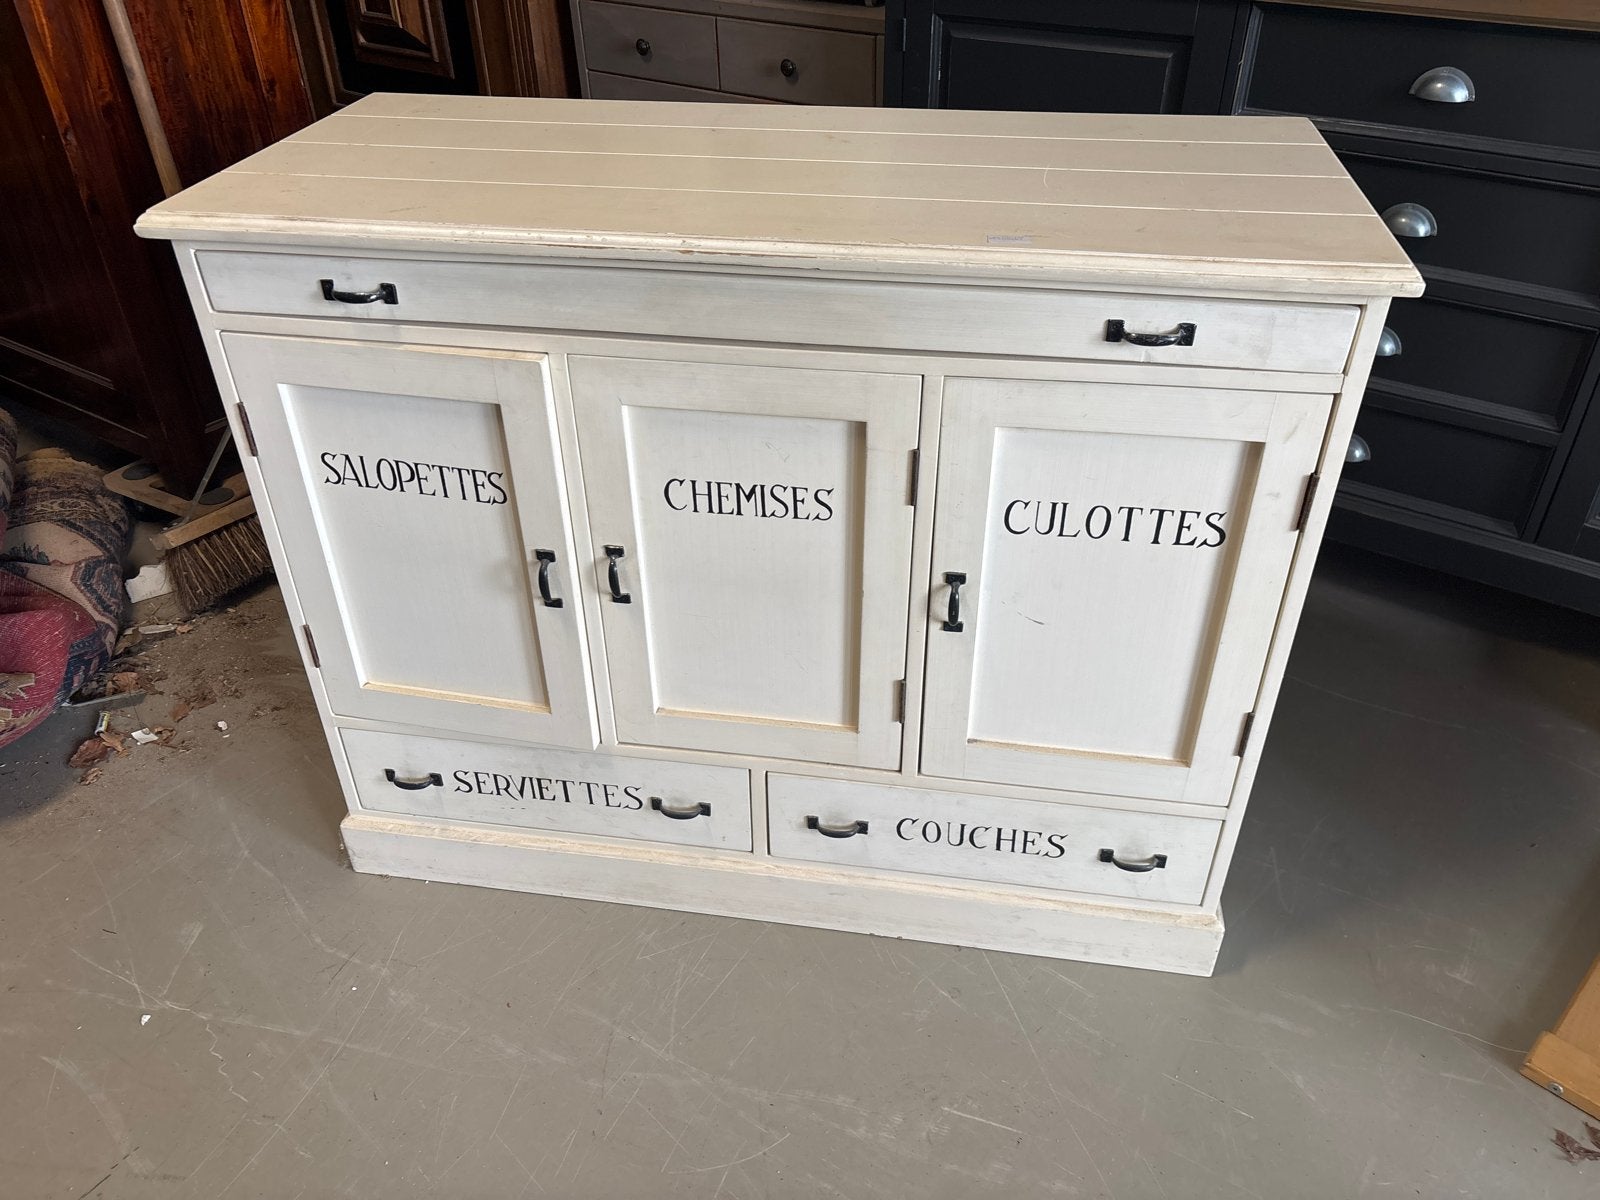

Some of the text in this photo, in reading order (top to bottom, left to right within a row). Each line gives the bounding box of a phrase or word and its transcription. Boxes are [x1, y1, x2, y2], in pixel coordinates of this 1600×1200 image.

[321, 452, 507, 505] SALOPETTES
[664, 478, 835, 521] CHEMISES
[1004, 499, 1228, 549] CULOTTES
[453, 770, 644, 810] SERVIETTES
[896, 817, 1068, 859] COUCHES
